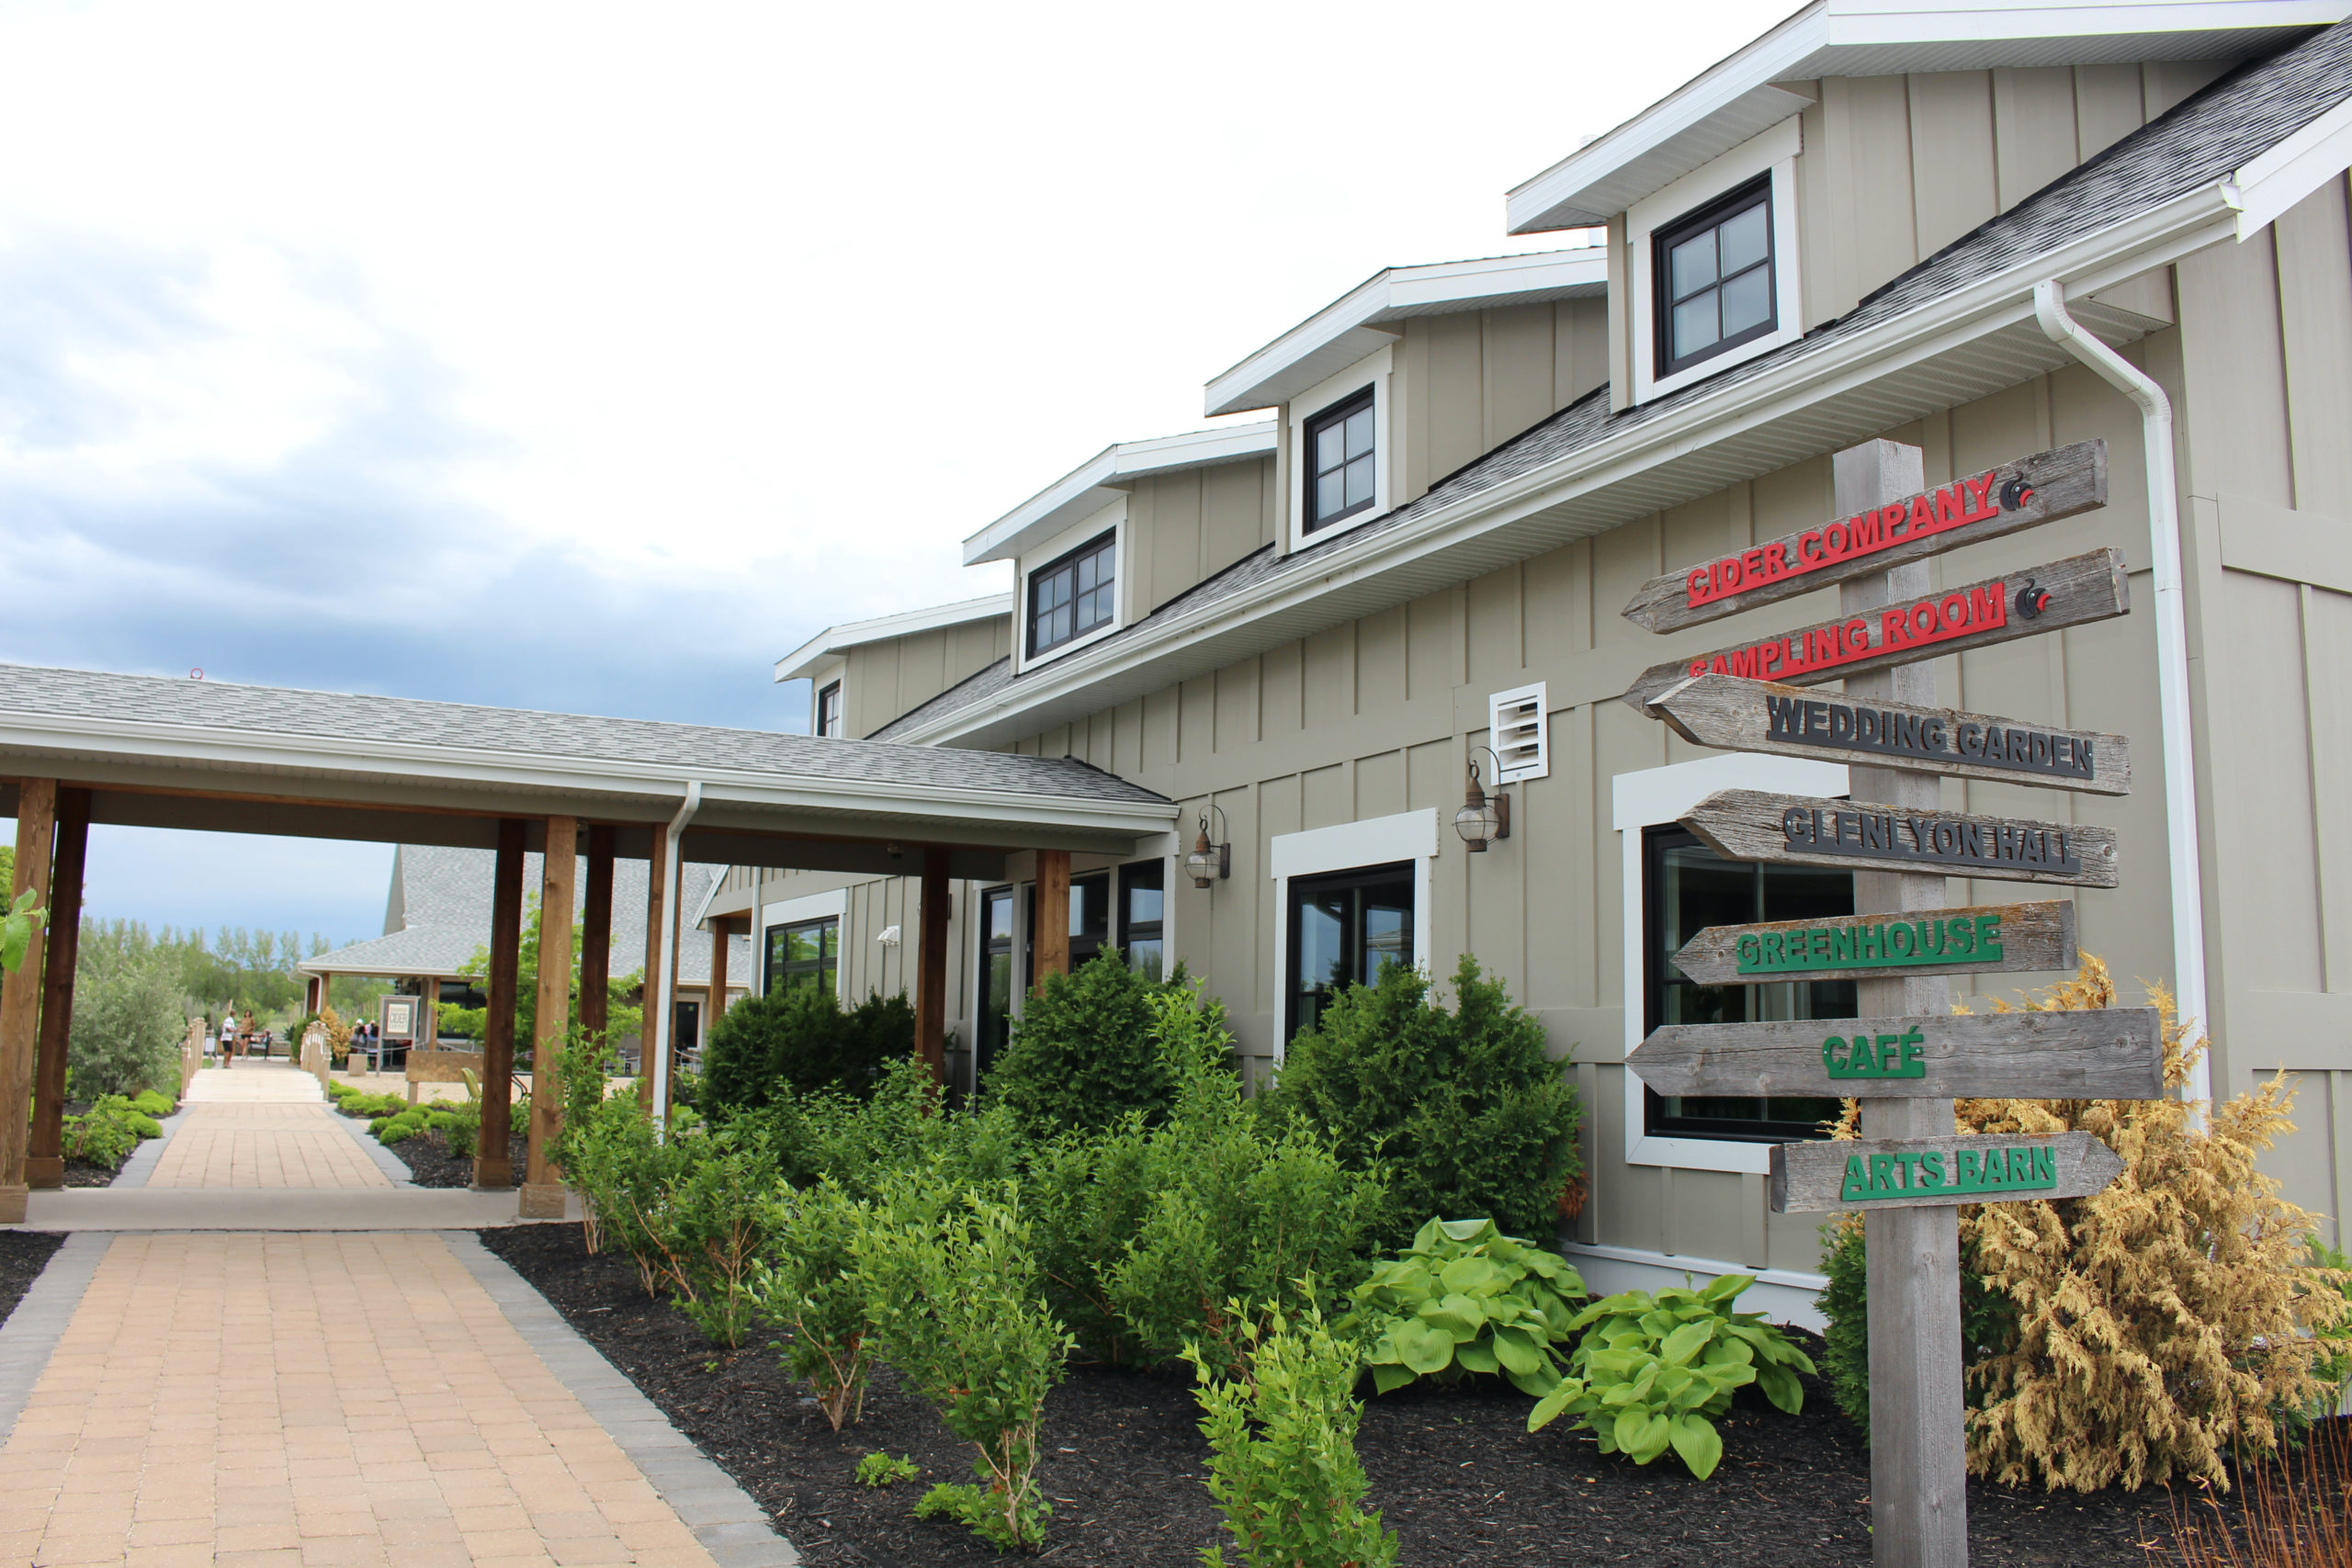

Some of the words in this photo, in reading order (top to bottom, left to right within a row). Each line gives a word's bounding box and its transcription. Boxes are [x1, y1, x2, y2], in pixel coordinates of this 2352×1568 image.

[1687, 541, 1787, 600] CIDER
[1796, 472, 1996, 562] COMPANY
[1689, 619, 1870, 681] SAMPLING
[1882, 581, 2006, 644] ROOM
[1766, 695, 1947, 752] WEDDING
[1959, 722, 2094, 772] GARDEN
[1783, 807, 1984, 858] GLENLYON
[1996, 826, 2076, 865] HALL
[1736, 916, 2002, 967] GREENHOUSE
[1822, 1025, 1925, 1073] CAFÉ
[1843, 1151, 1946, 1192] ARTS
[1958, 1146, 2056, 1186] BARN
